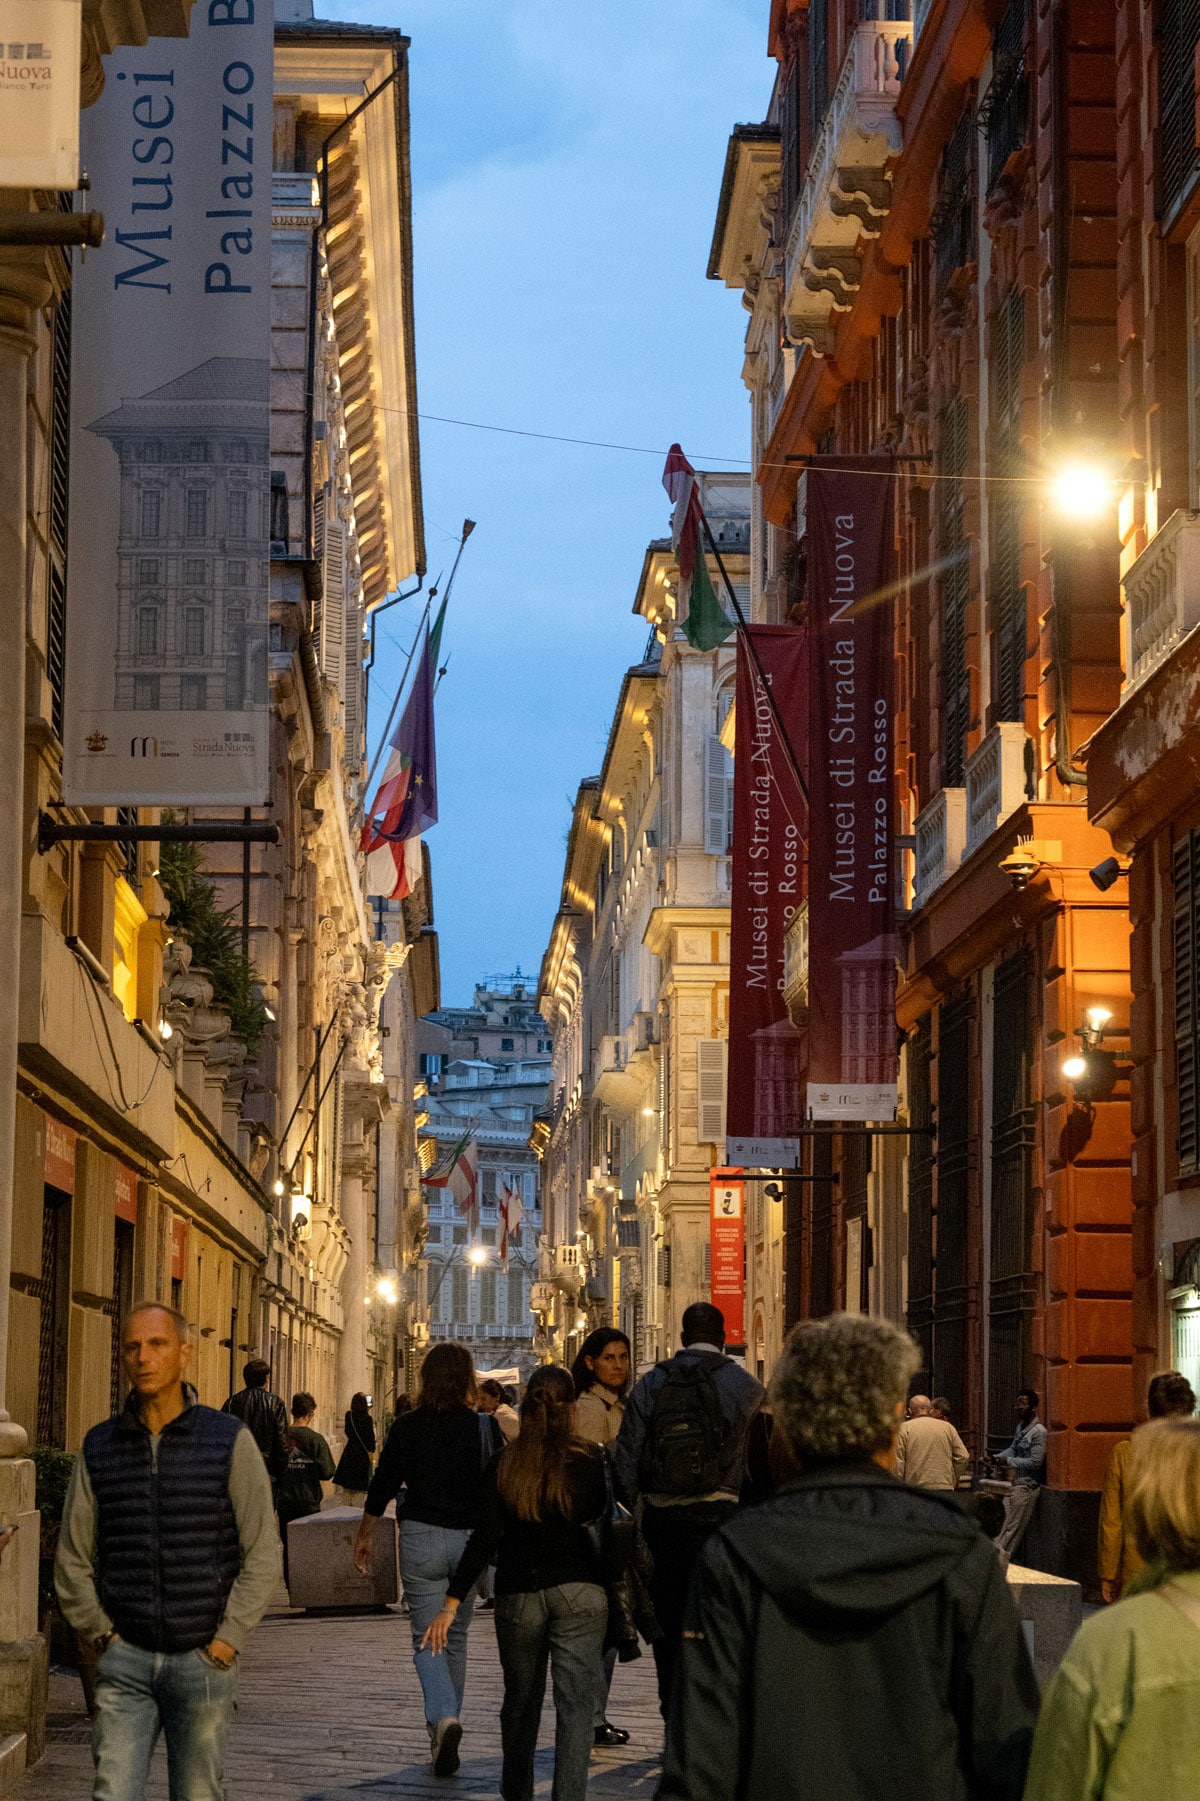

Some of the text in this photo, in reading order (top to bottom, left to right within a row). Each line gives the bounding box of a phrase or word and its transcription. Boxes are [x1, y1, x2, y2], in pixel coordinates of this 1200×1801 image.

[114, 69, 174, 295] Musei
[204, 60, 254, 294] Palazzo
[829, 513, 855, 902] Musei di Strada Nuova
[749, 776, 771, 860] Strada
[778, 824, 798, 894] Rosso
[868, 698, 888, 903] Palazzo Rosso
[746, 907, 769, 989] Musei
[748, 871, 769, 895] di
